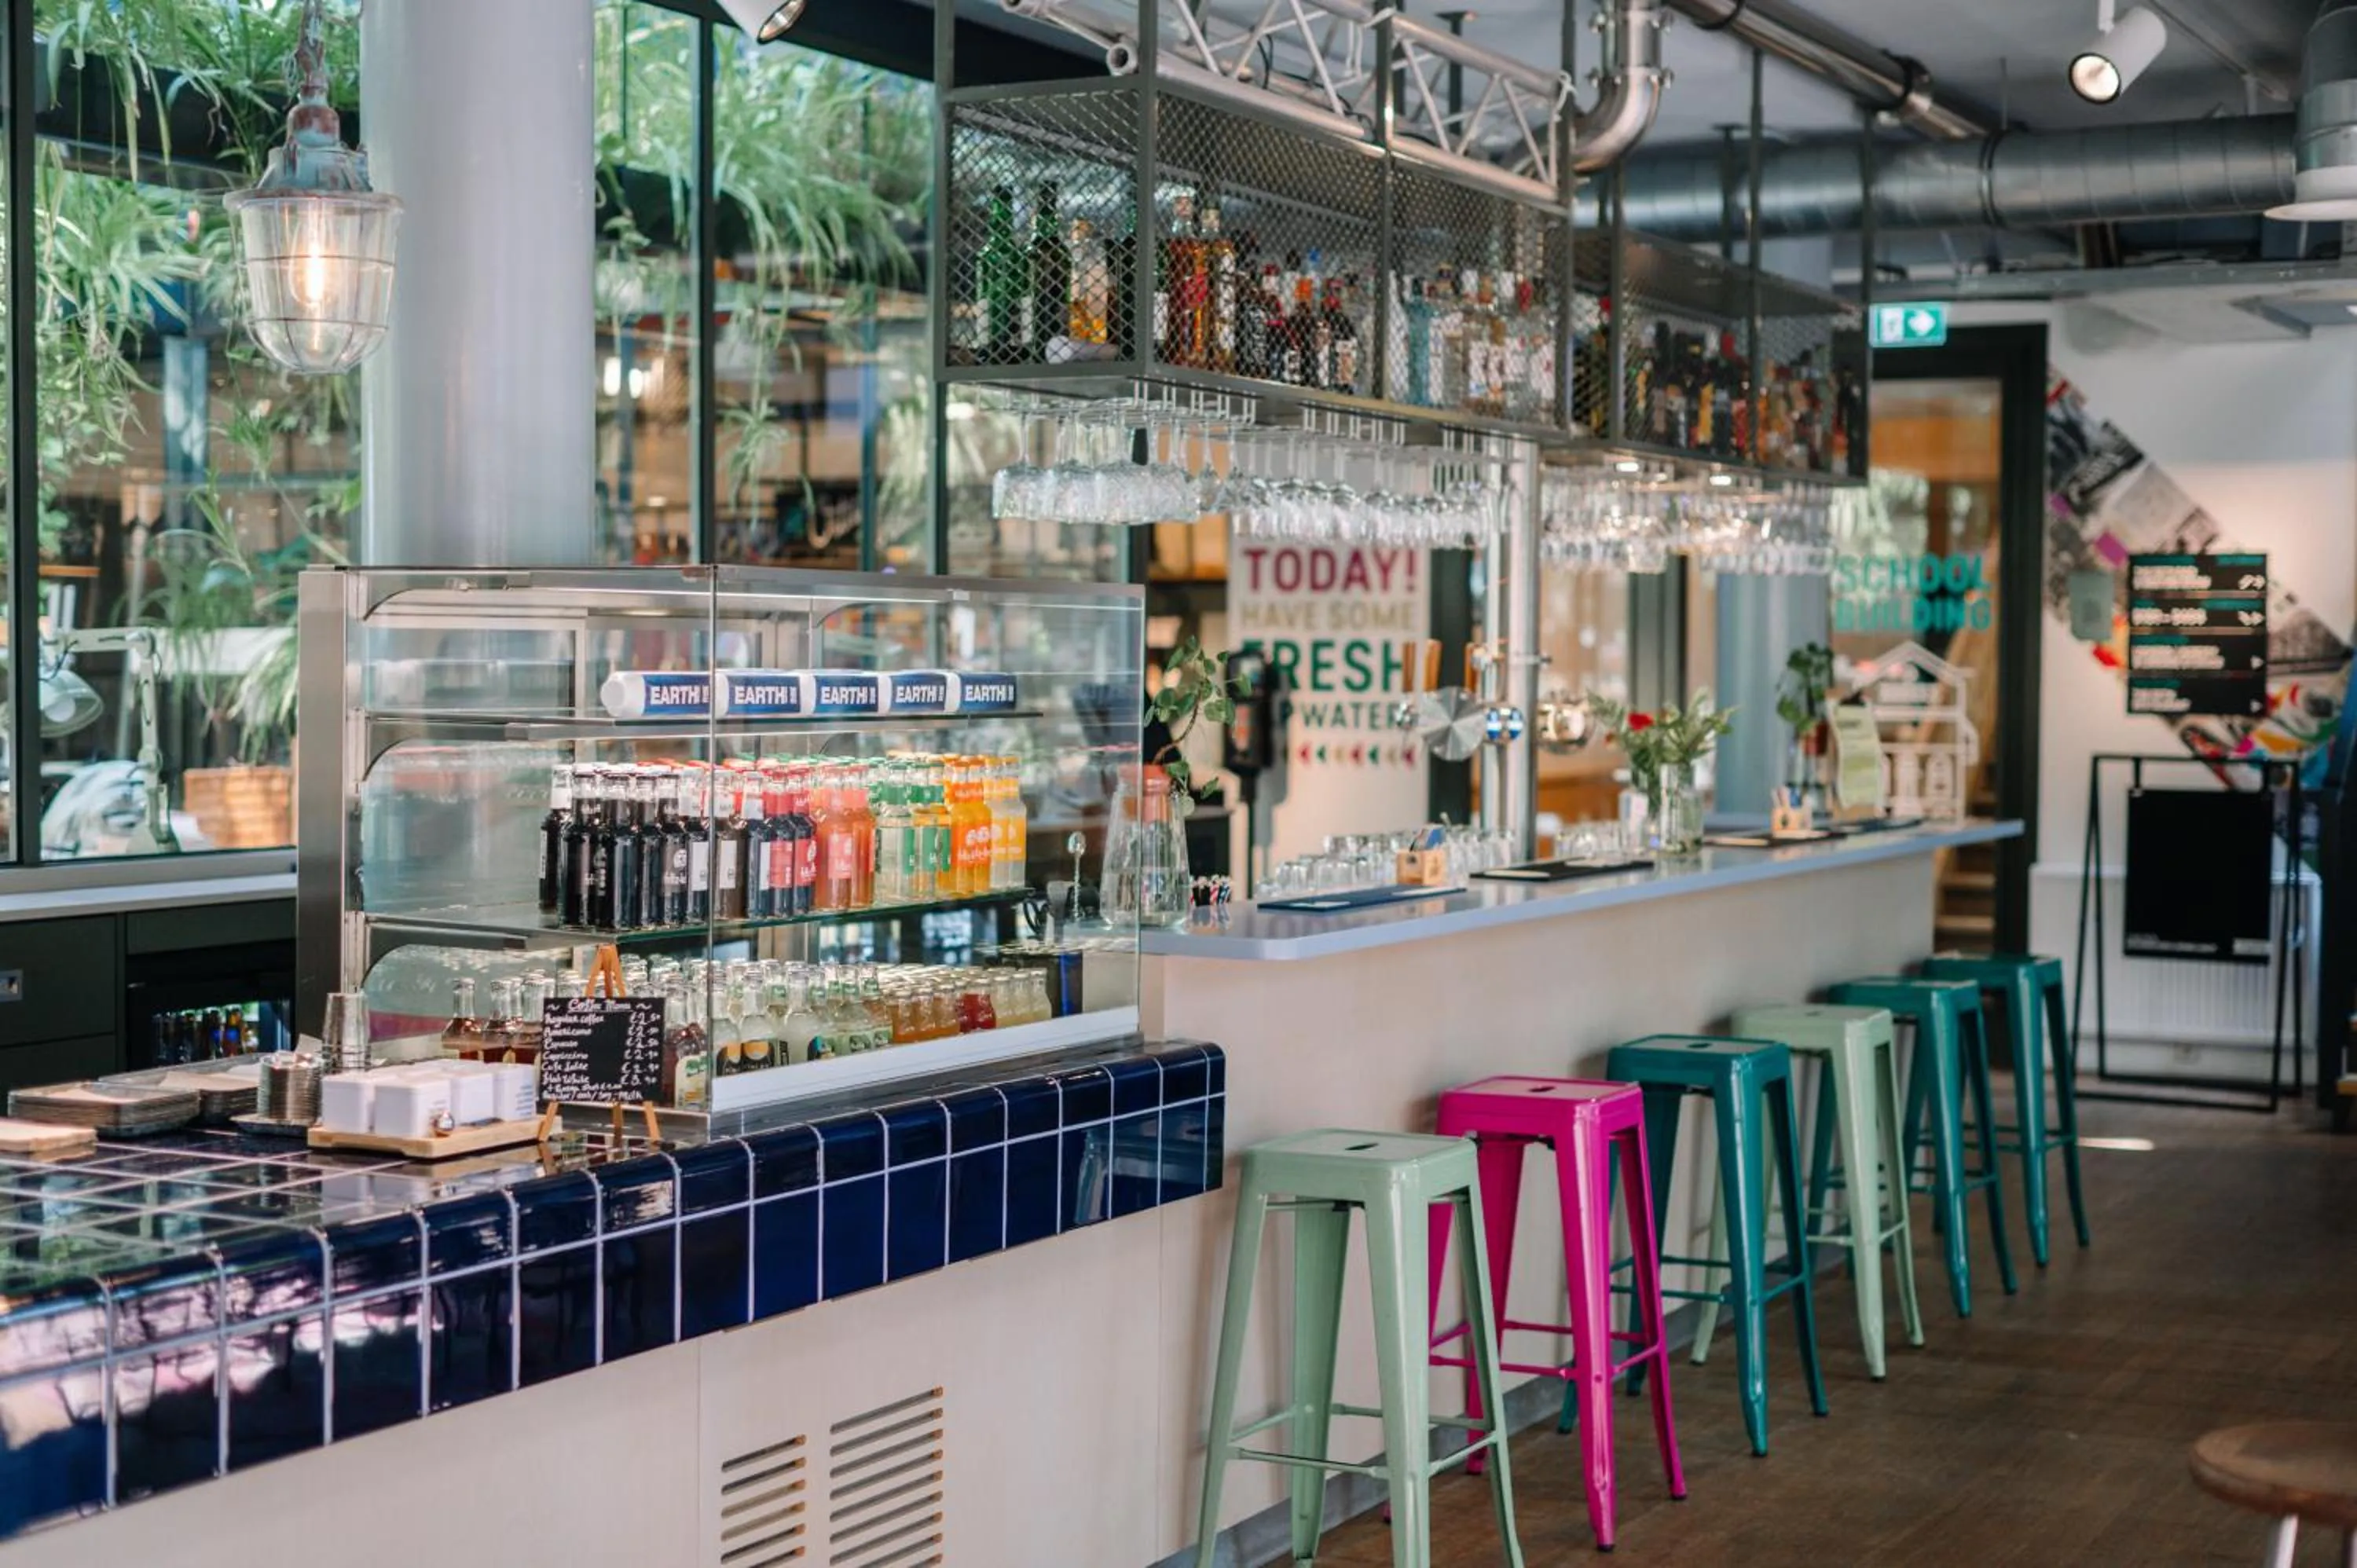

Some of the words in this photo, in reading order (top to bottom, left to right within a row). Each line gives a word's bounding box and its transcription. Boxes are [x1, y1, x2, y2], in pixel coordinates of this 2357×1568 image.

[1243, 548, 1417, 593] TODAY!
[1835, 552, 1990, 592] SCHOOL
[1241, 601, 1318, 628] HAVE
[1329, 600, 1413, 629] SOME
[1835, 598, 1991, 631] BUILDING
[651, 686, 700, 705] EARTH
[735, 686, 786, 705] EARTH
[820, 687, 867, 705] EARTH
[895, 686, 938, 703] EARTH
[965, 685, 1006, 702] EARTH
